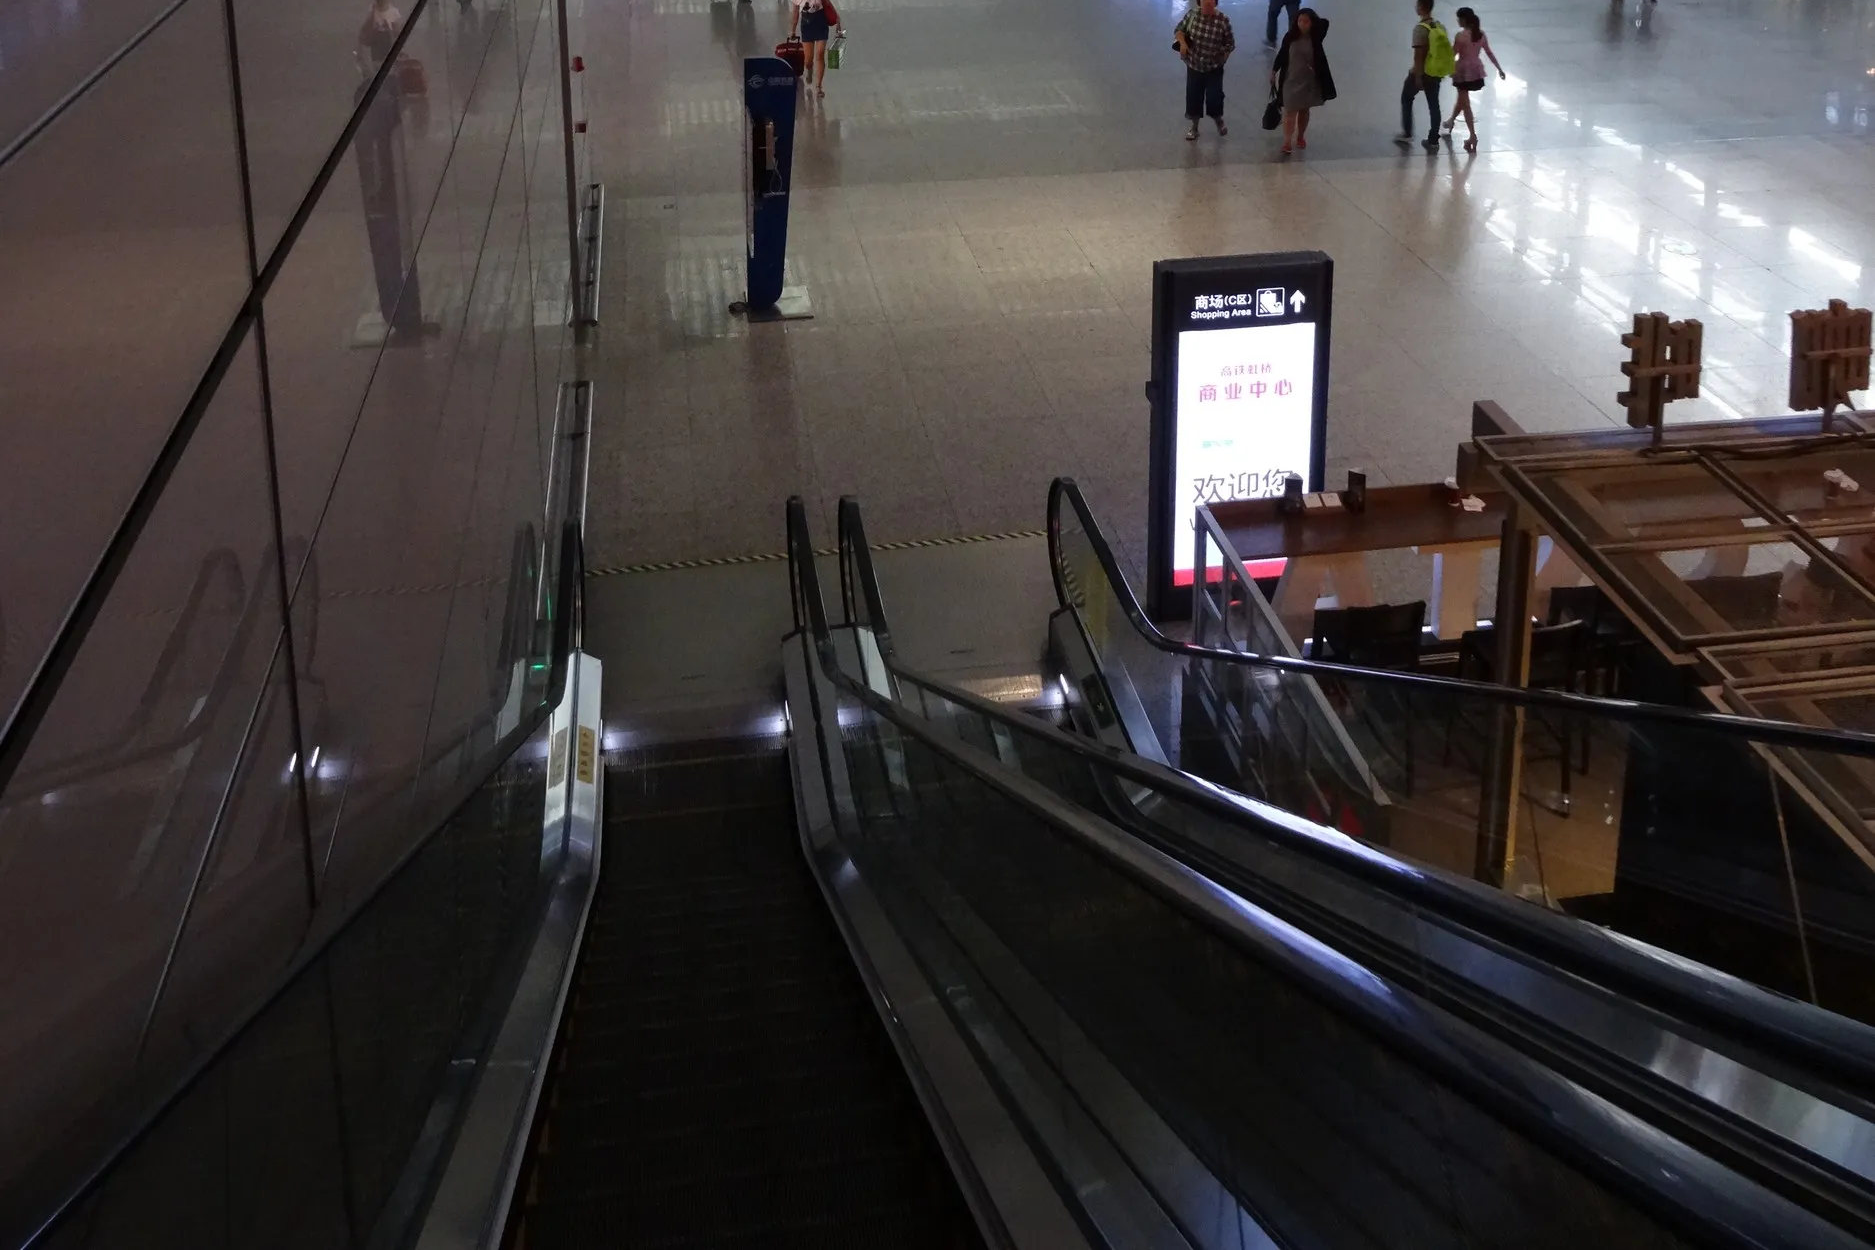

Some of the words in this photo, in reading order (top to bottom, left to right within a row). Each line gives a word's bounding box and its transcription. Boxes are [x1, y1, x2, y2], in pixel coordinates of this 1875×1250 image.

[1190, 310, 1230, 320] Shopping
[1231, 308, 1252, 317] Area
[1220, 362, 1273, 377] 高铁虹桥
[1199, 378, 1293, 403] 商业中心
[1193, 468, 1291, 503] 欢迎您
